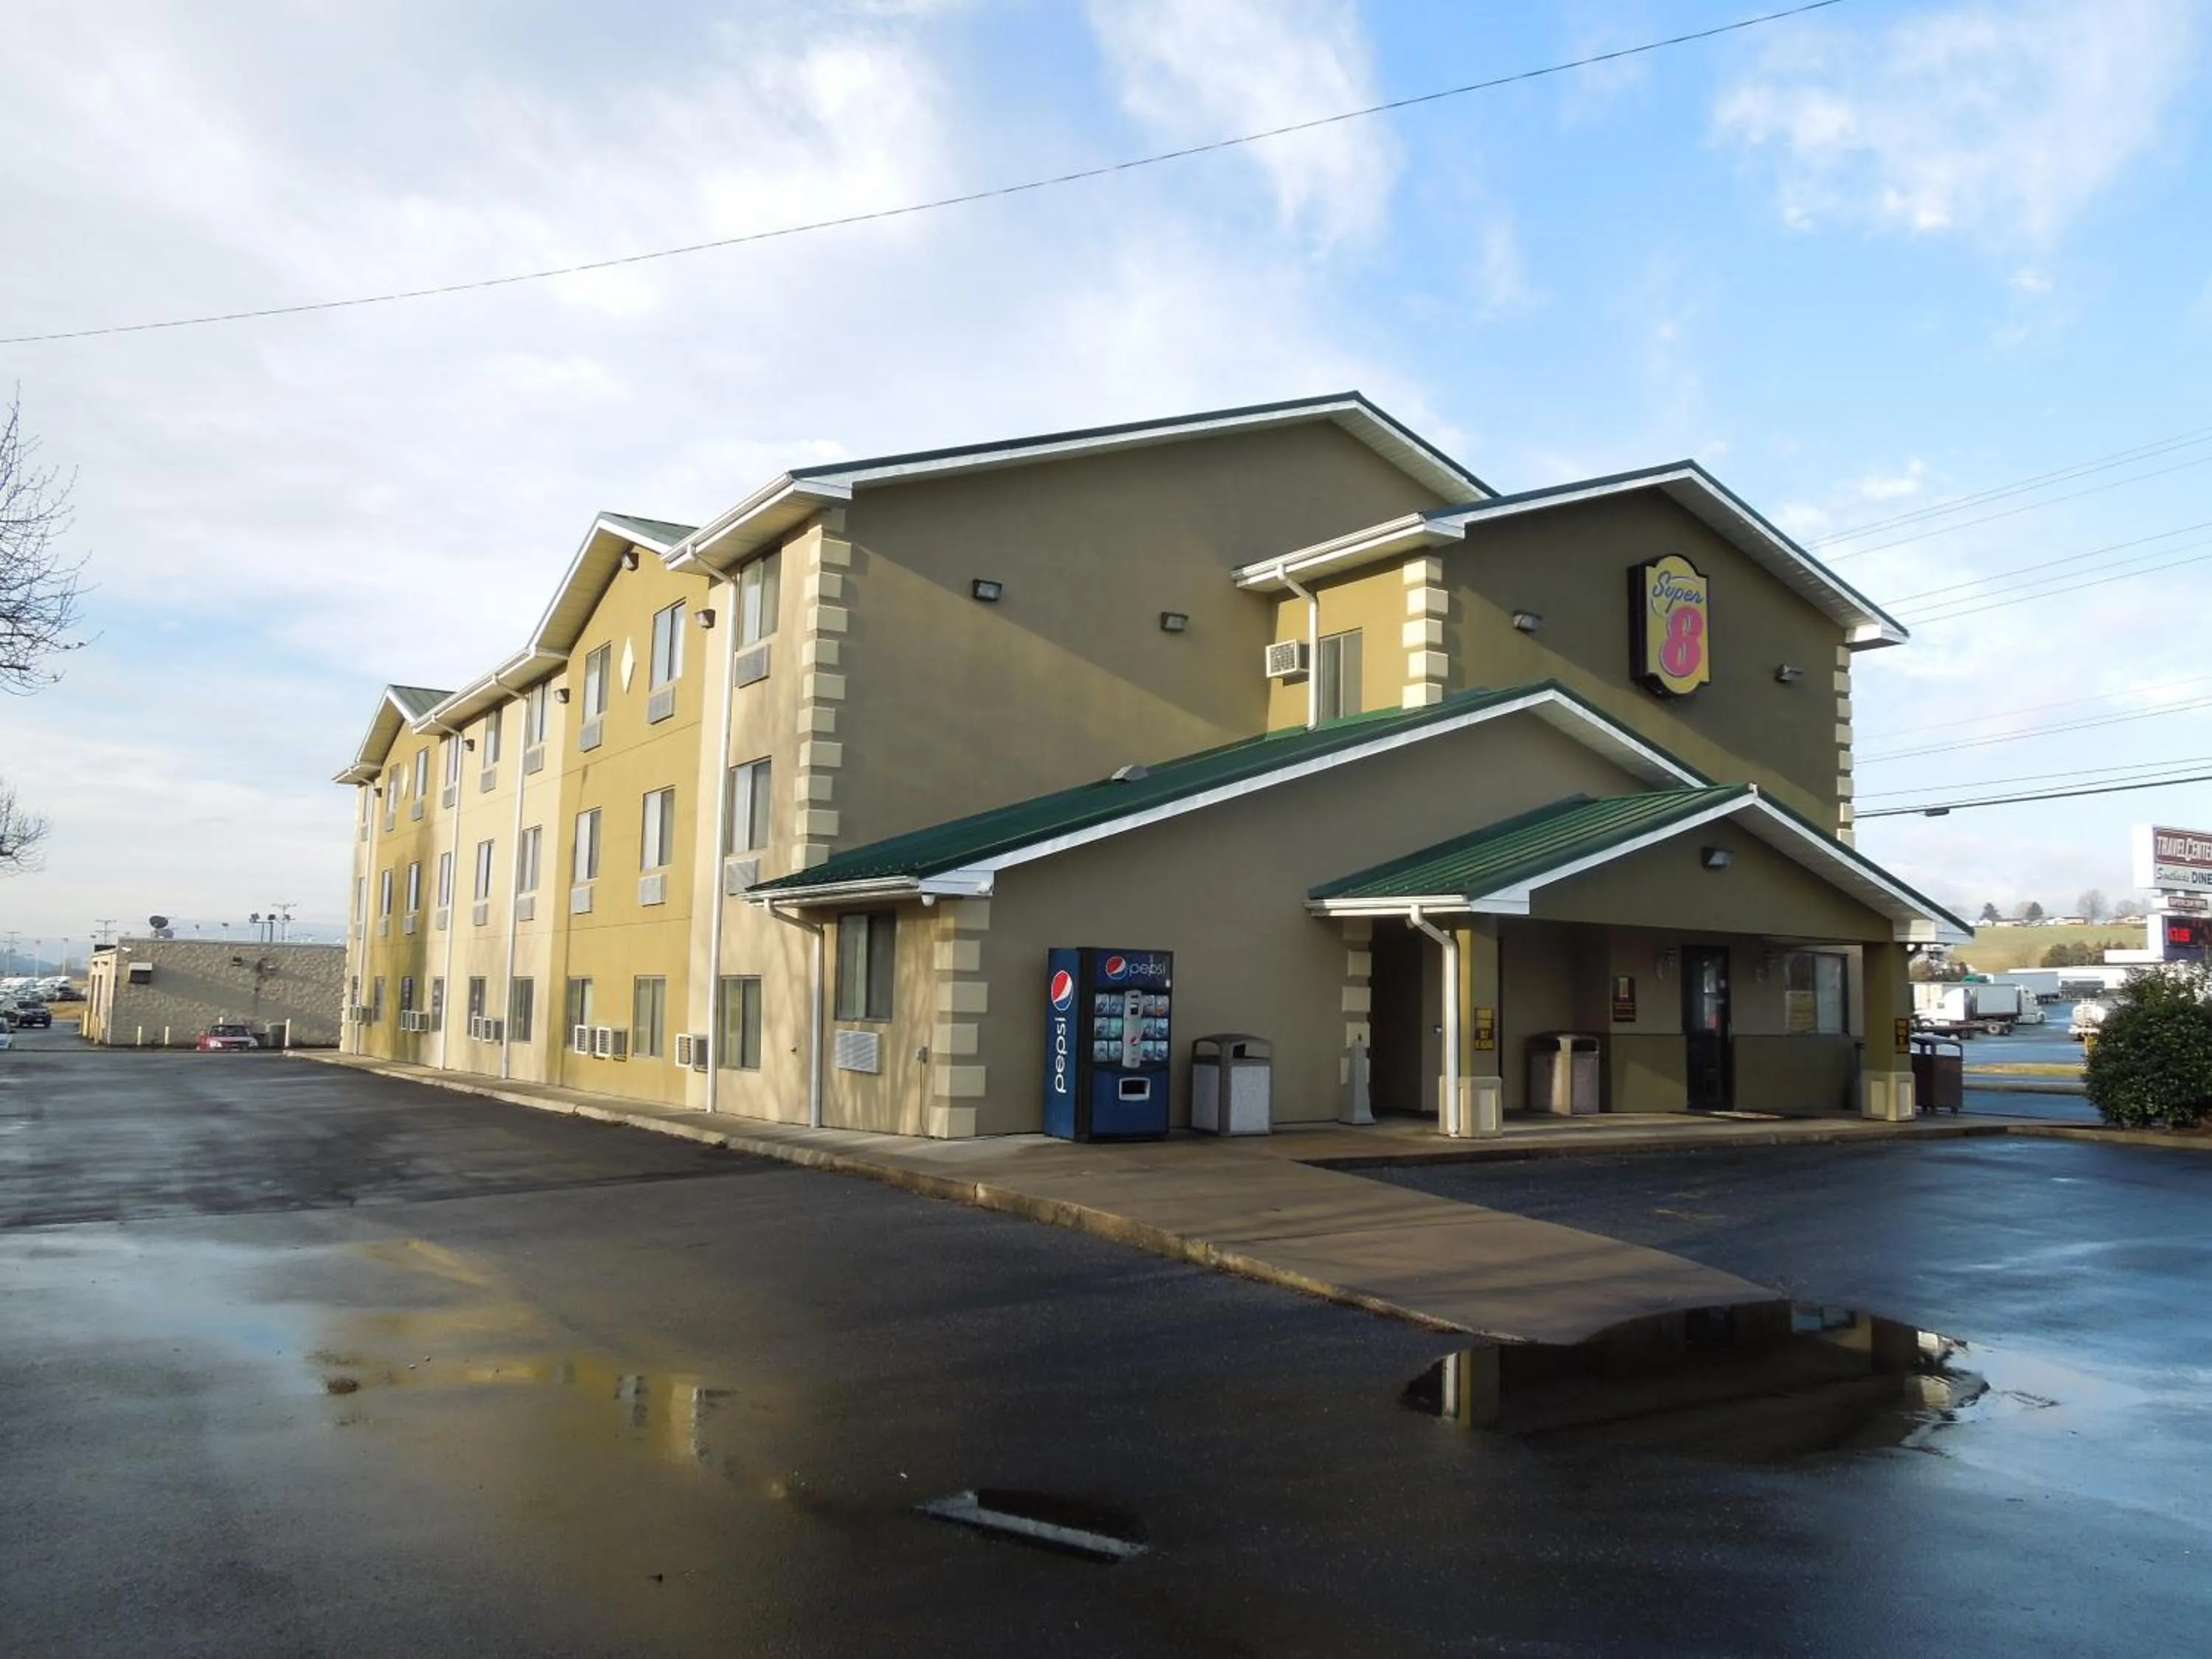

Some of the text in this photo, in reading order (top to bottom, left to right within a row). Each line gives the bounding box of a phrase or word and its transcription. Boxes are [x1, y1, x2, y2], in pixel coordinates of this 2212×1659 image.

[1652, 571, 1703, 613] Super
[1659, 606, 1703, 678] 8
[1129, 961, 1166, 977] pepsi
[1054, 1017, 1068, 1093] pepsi
